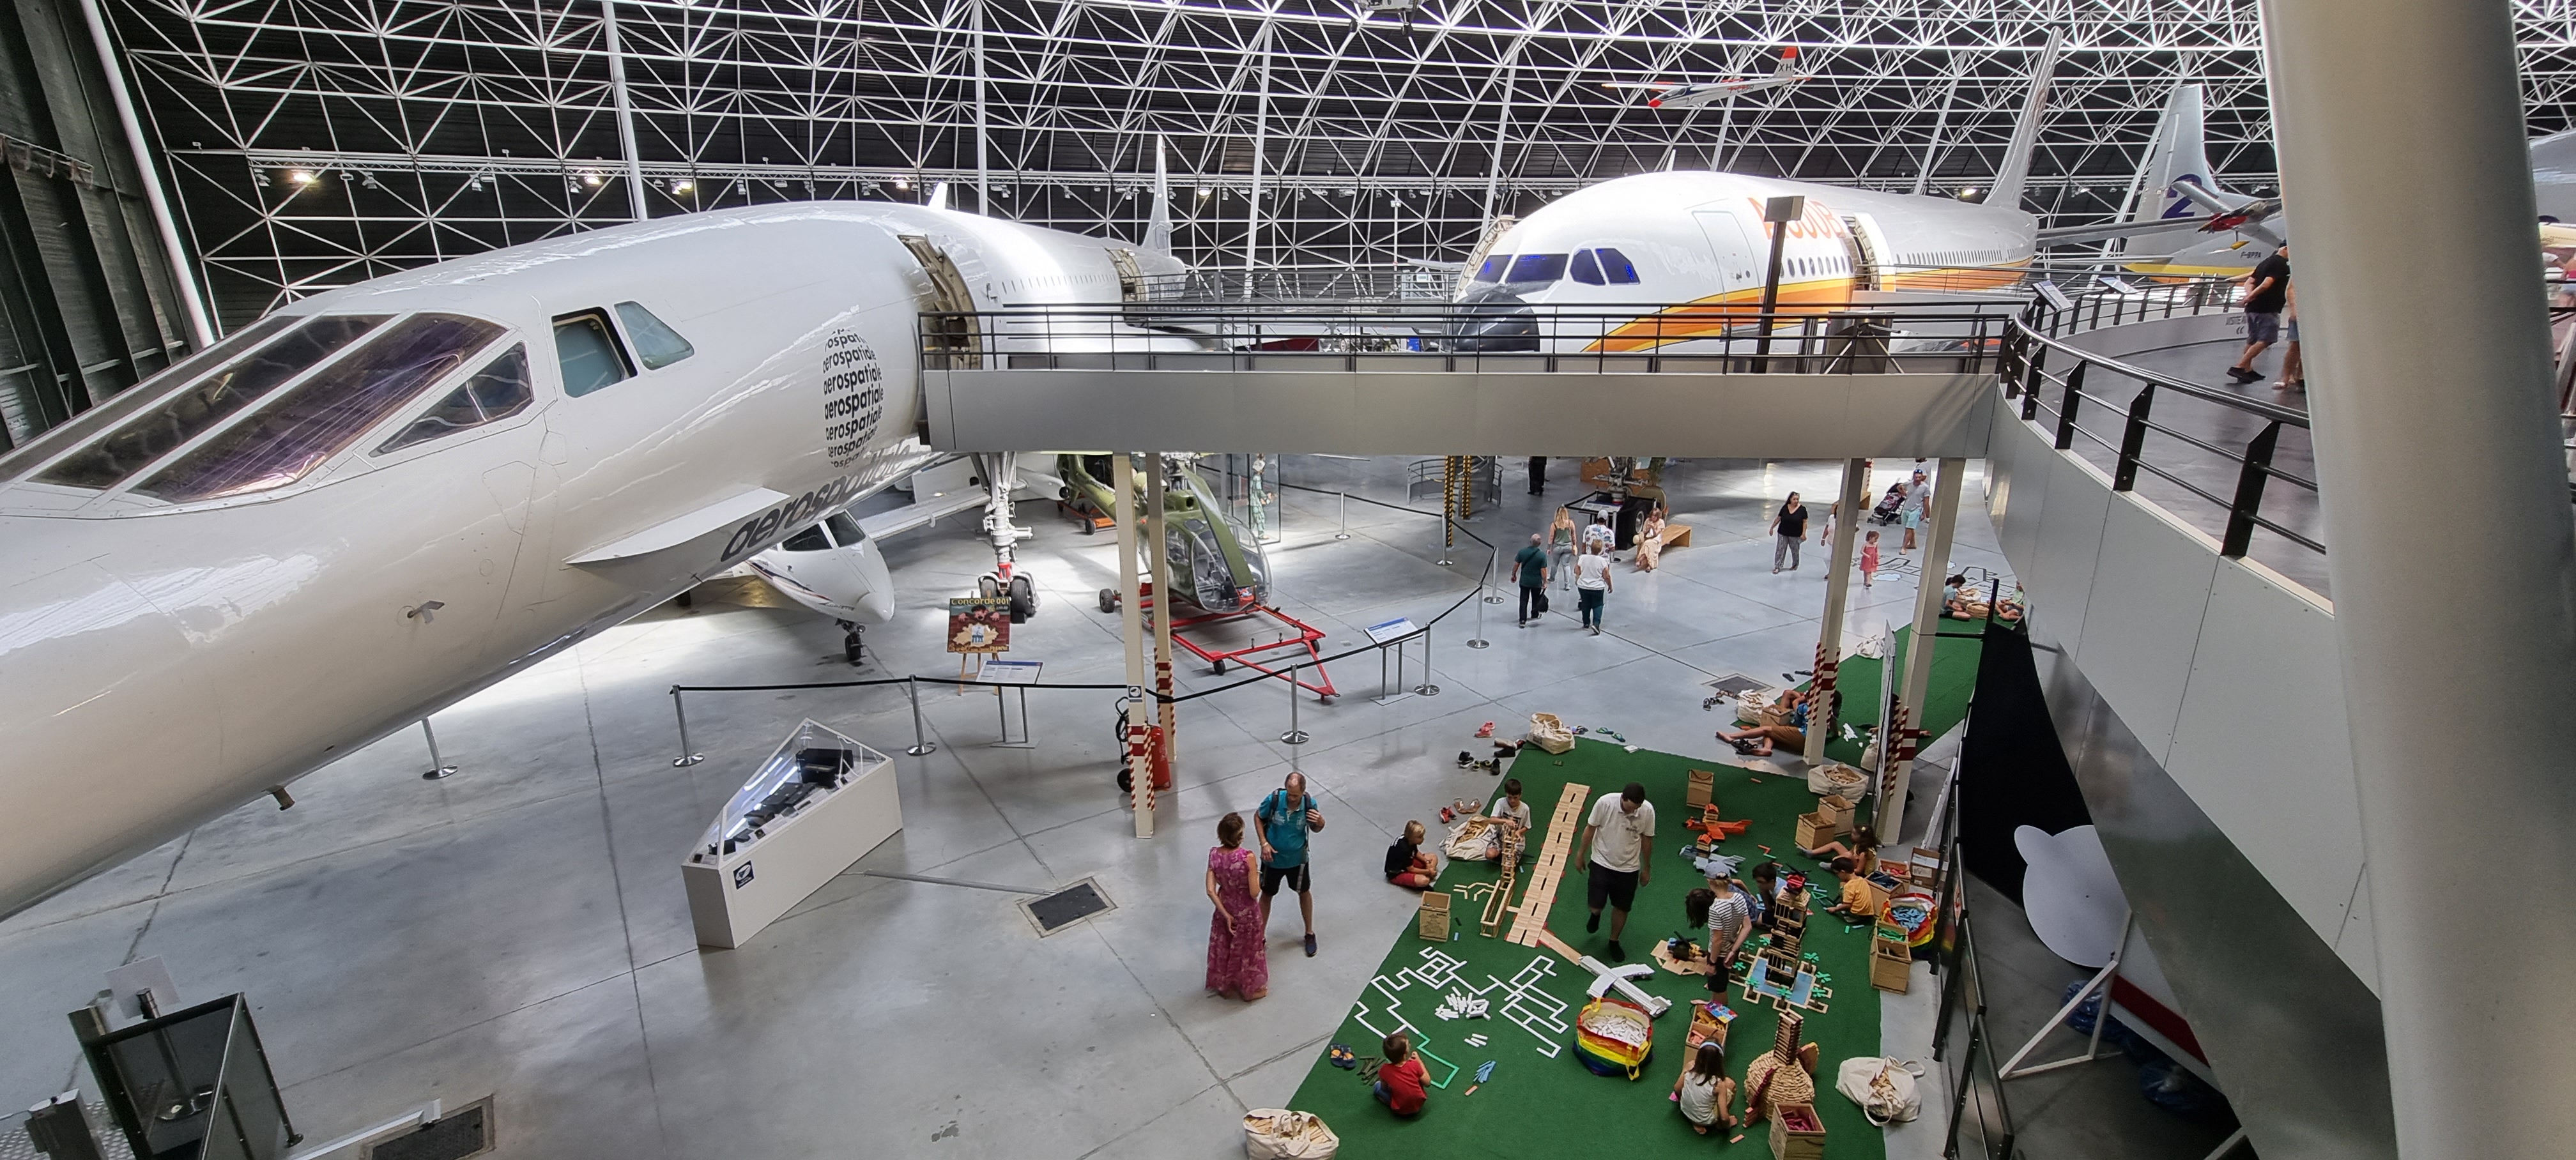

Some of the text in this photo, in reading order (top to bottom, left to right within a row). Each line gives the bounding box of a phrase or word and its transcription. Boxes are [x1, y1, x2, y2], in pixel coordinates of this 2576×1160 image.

[1779, 63, 1792, 72] XH
[2161, 173, 2202, 219] 2
[824, 362, 882, 395] aerospatiale
[824, 383, 884, 420] aerospatiale
